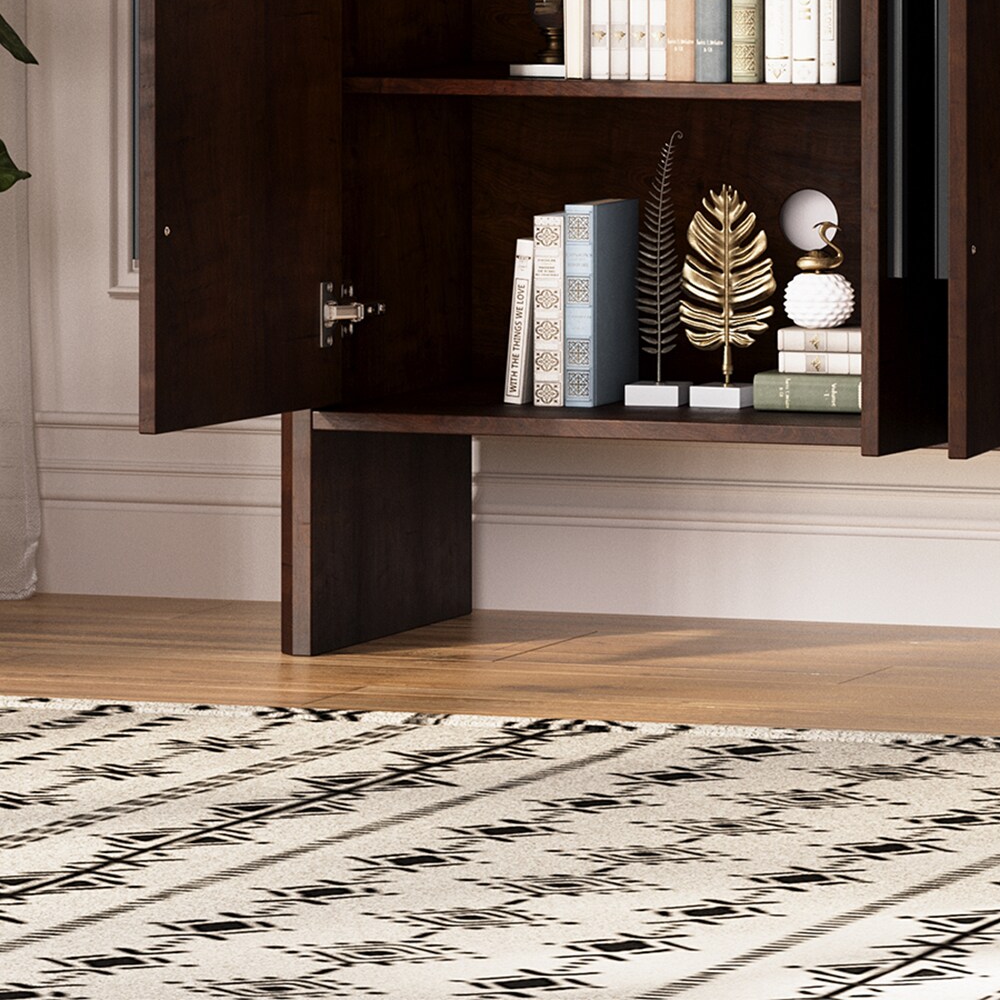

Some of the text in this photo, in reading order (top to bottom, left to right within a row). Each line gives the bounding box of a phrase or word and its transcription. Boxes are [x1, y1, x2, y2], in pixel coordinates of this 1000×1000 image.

[509, 284, 526, 393] WITH THE THINGS WE LOVE
